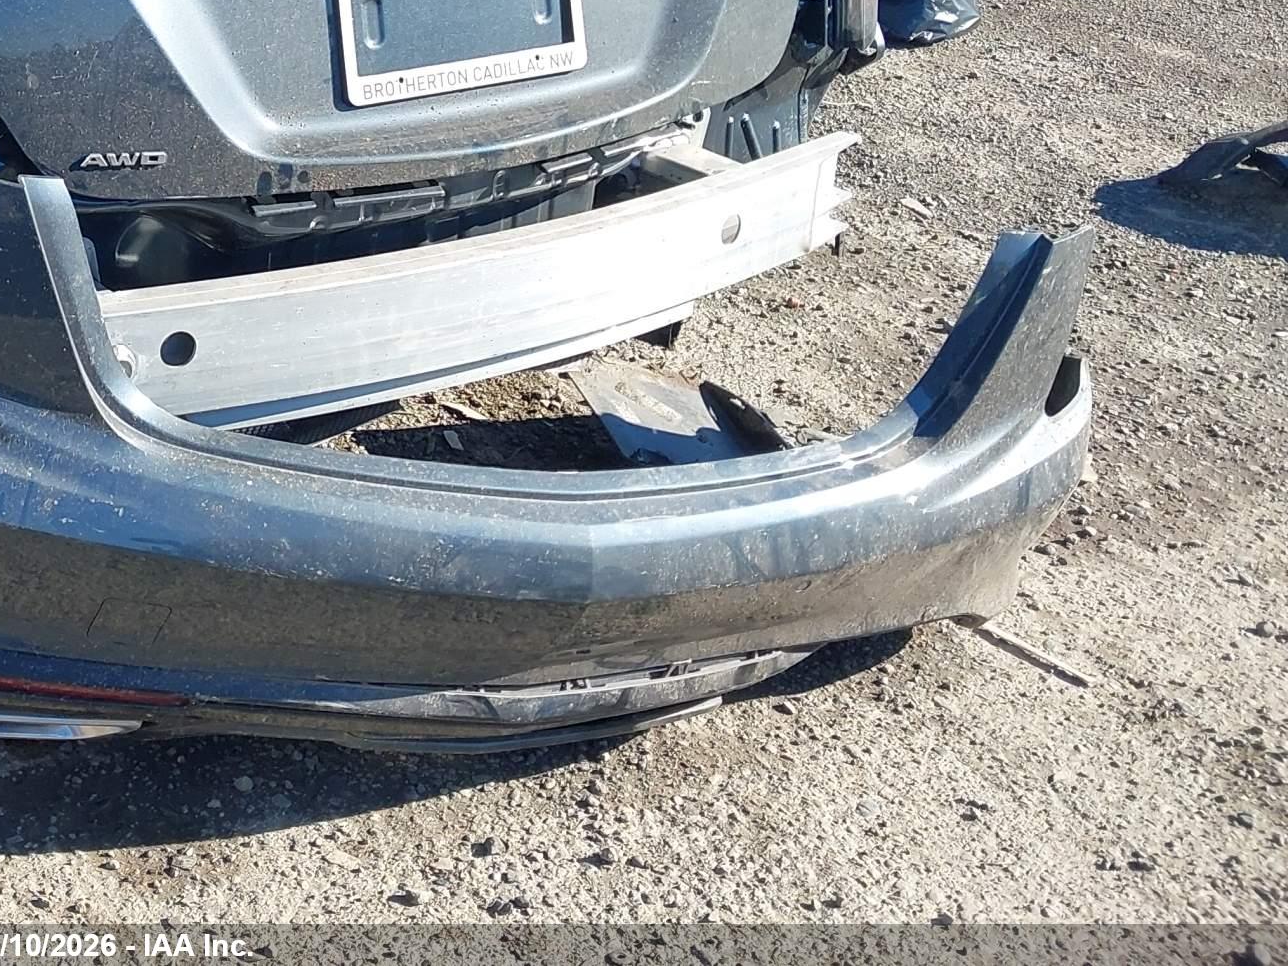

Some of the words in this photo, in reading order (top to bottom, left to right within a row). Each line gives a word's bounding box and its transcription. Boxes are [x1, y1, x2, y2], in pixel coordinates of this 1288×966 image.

[363, 70, 468, 100] BROTHERTON
[473, 57, 545, 82] CADILLAC
[550, 50, 574, 67] NW
[80, 151, 169, 168] AWD
